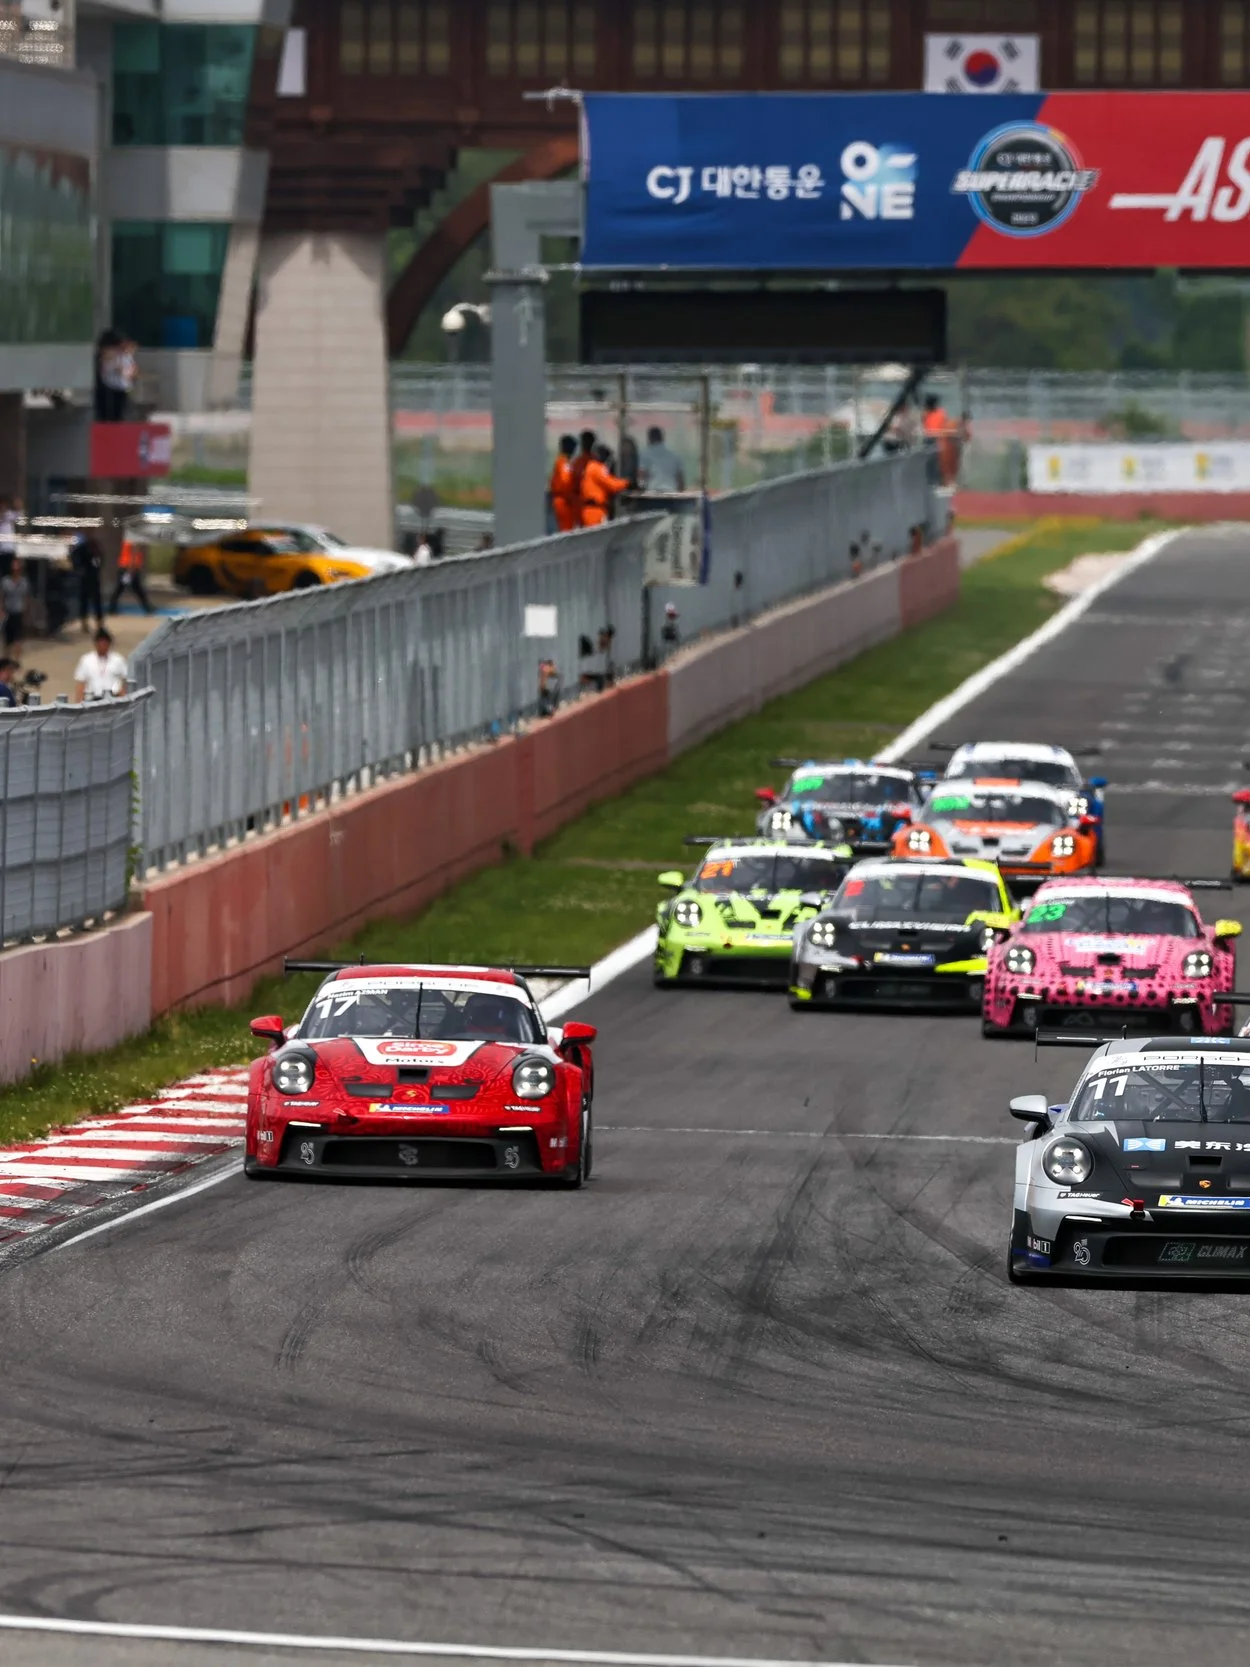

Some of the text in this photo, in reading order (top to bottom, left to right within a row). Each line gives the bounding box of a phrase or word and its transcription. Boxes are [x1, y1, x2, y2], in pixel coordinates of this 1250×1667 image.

[646, 163, 826, 205] CJ 대한통운
[315, 995, 359, 1019] 17
[1098, 1068, 1130, 1078] Florian
[1088, 1075, 1129, 1100] 11
